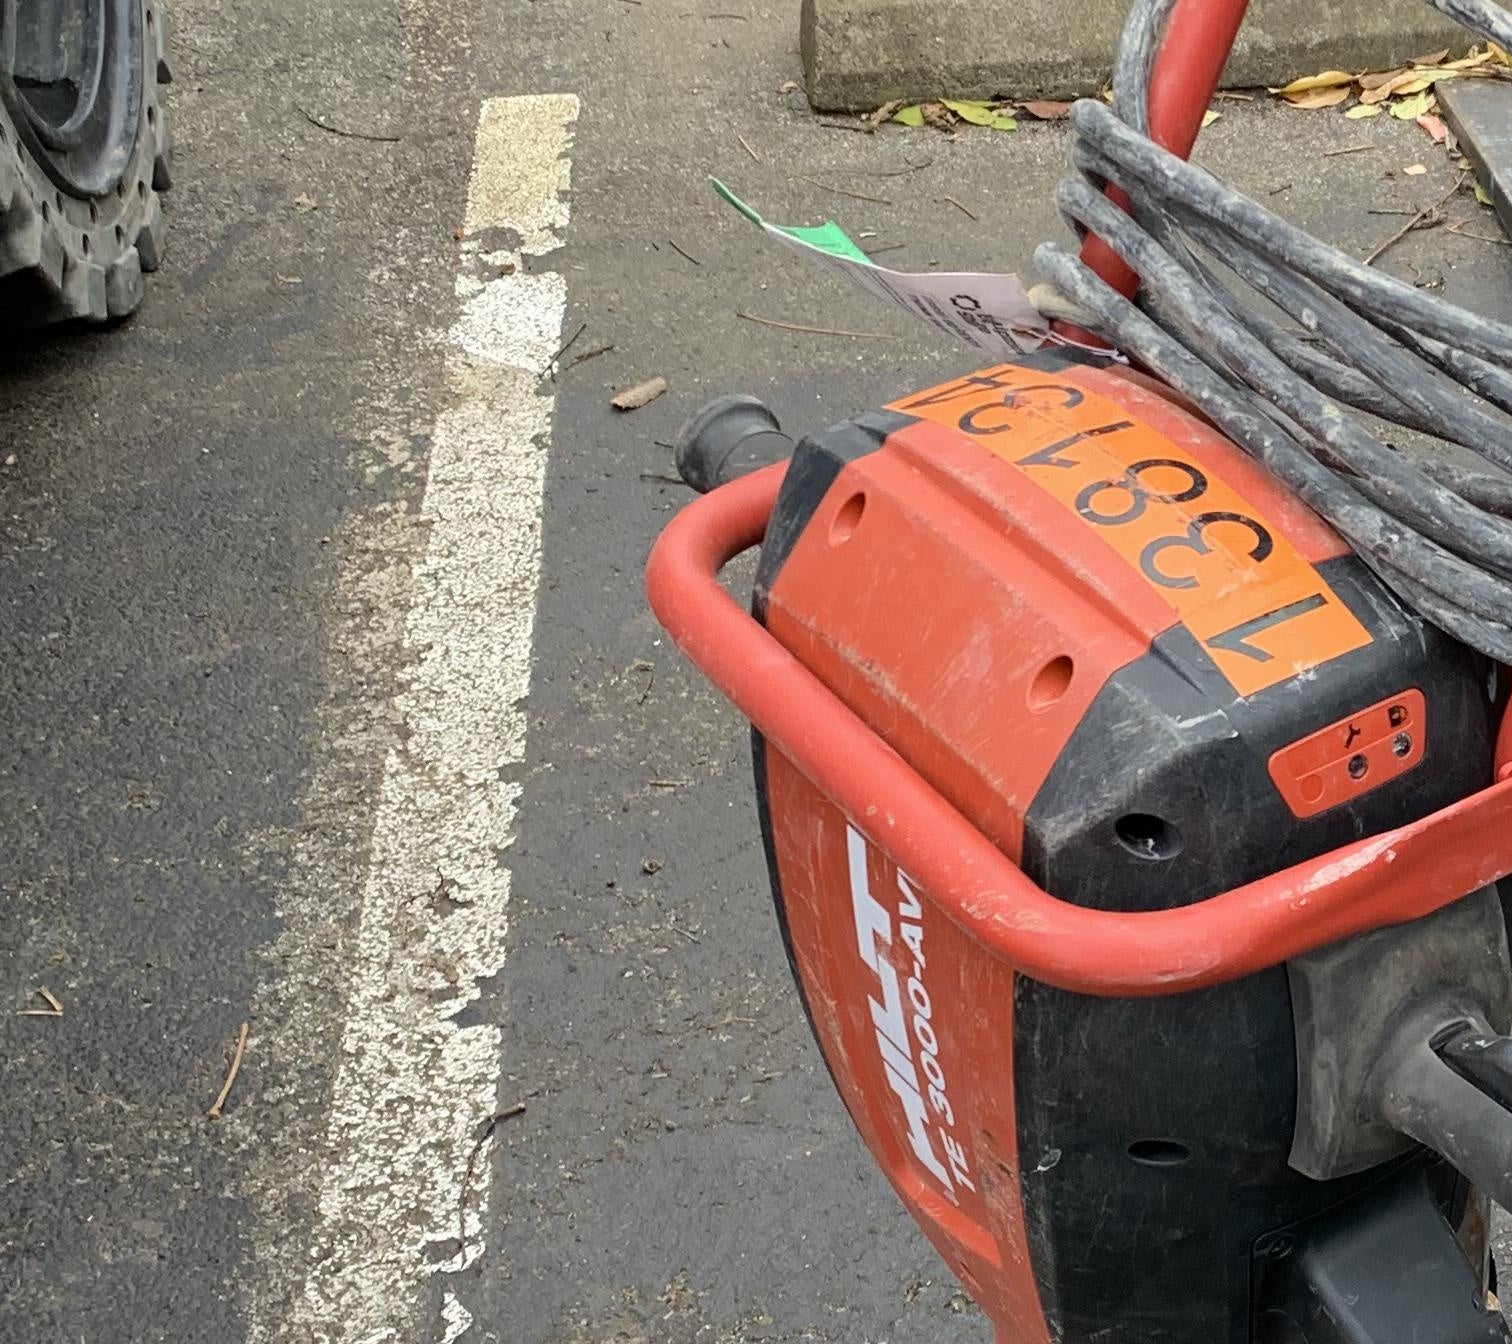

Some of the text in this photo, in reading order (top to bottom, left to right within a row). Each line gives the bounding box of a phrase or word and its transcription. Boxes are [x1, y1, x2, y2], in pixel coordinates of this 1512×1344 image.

[910, 367, 1331, 664] 138134
[846, 824, 959, 1207] HILT
[896, 867, 976, 1194] TE 3000-AV
